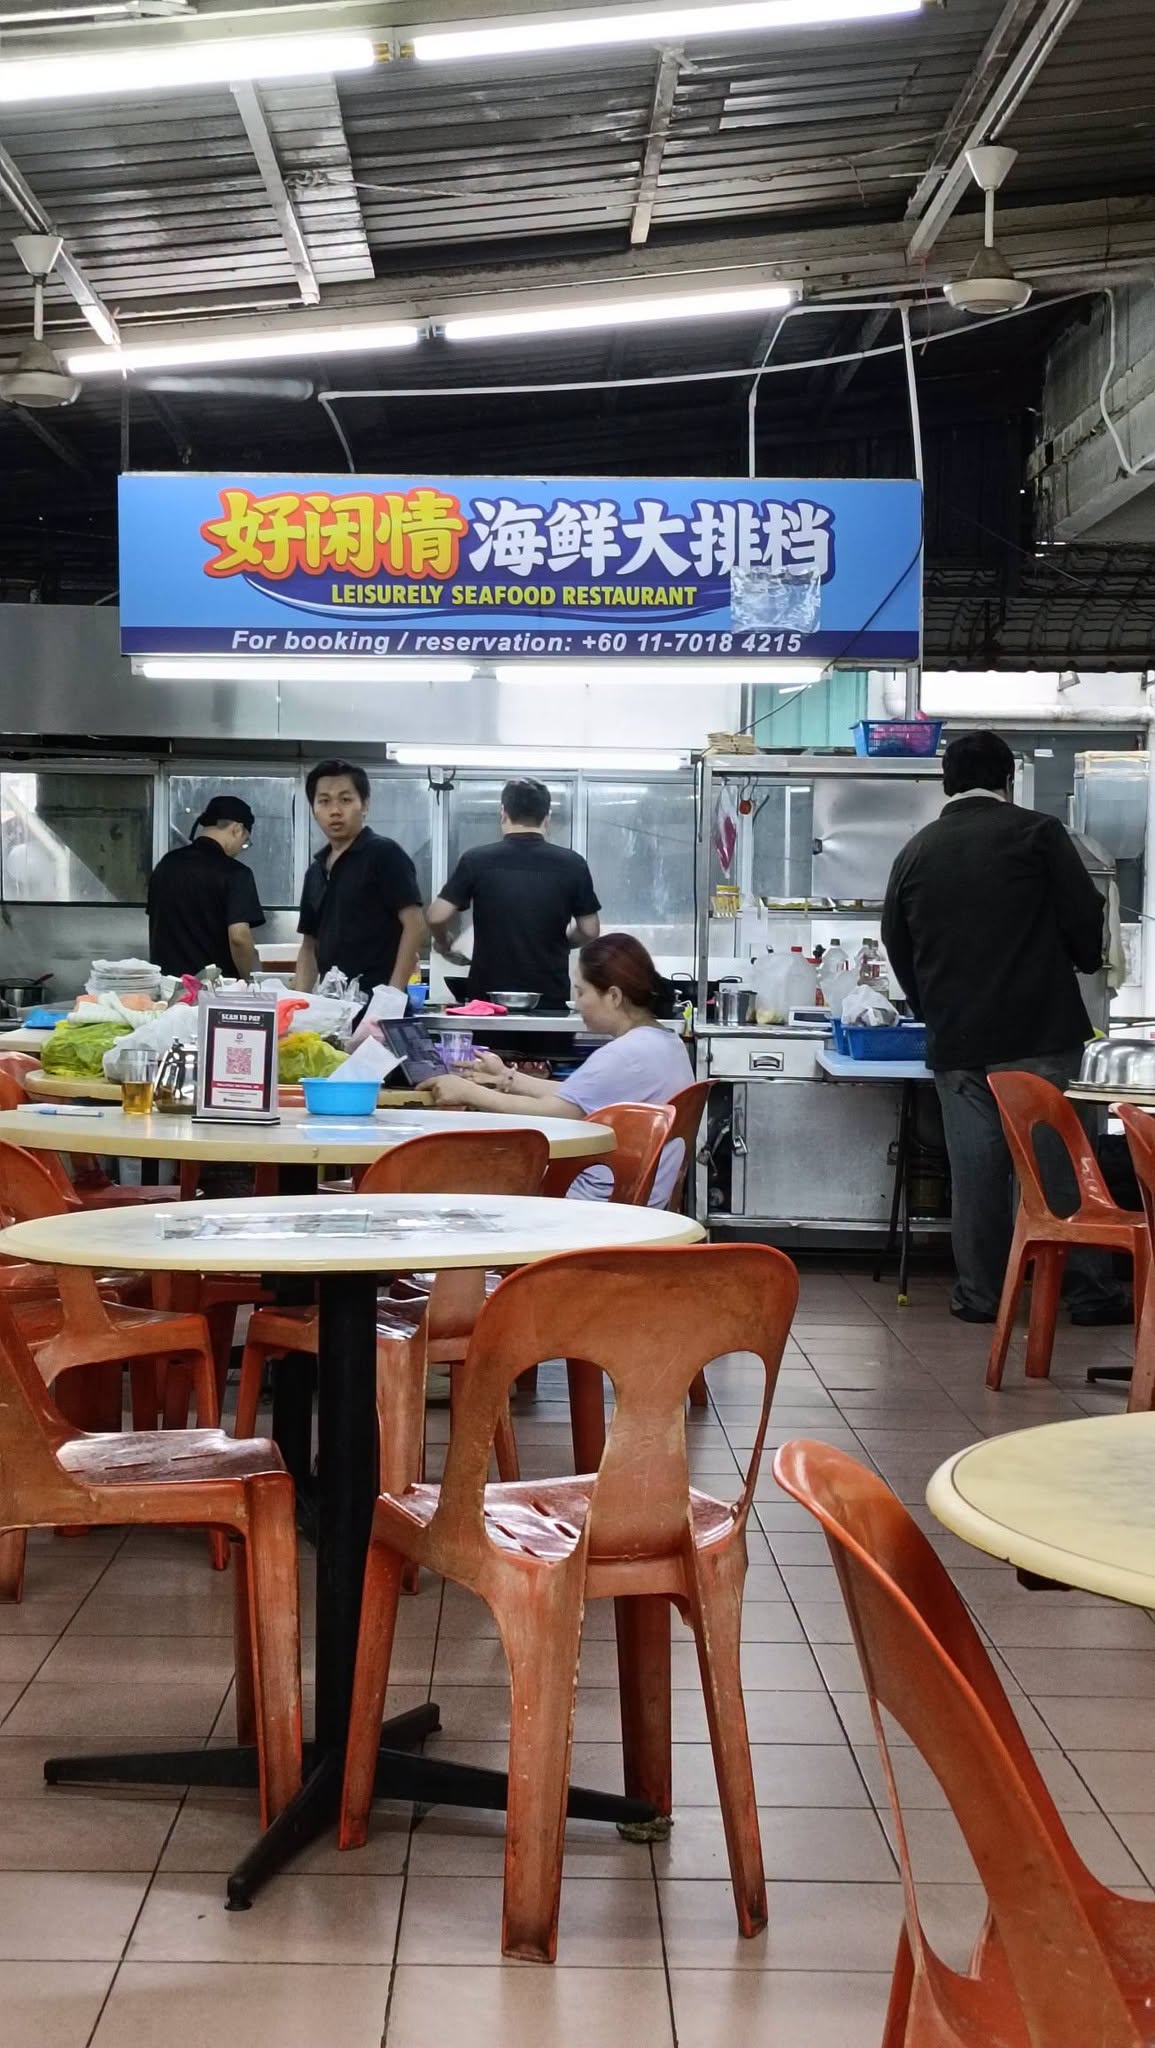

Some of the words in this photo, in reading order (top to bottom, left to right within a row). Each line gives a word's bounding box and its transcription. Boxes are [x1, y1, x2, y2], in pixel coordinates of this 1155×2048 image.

[207, 490, 463, 574] 好闲情
[468, 501, 829, 577] 海鲜大排档
[331, 583, 443, 605] LEISURELY
[451, 584, 556, 606] SEAFOOD
[562, 585, 697, 606] RESTAURANT
[231, 630, 277, 650] For
[284, 631, 390, 654] booking
[397, 632, 409, 651] /
[415, 632, 572, 652] reservation:
[582, 633, 627, 652] +60
[637, 633, 733, 652] 11-7018
[741, 633, 801, 652] 4215
